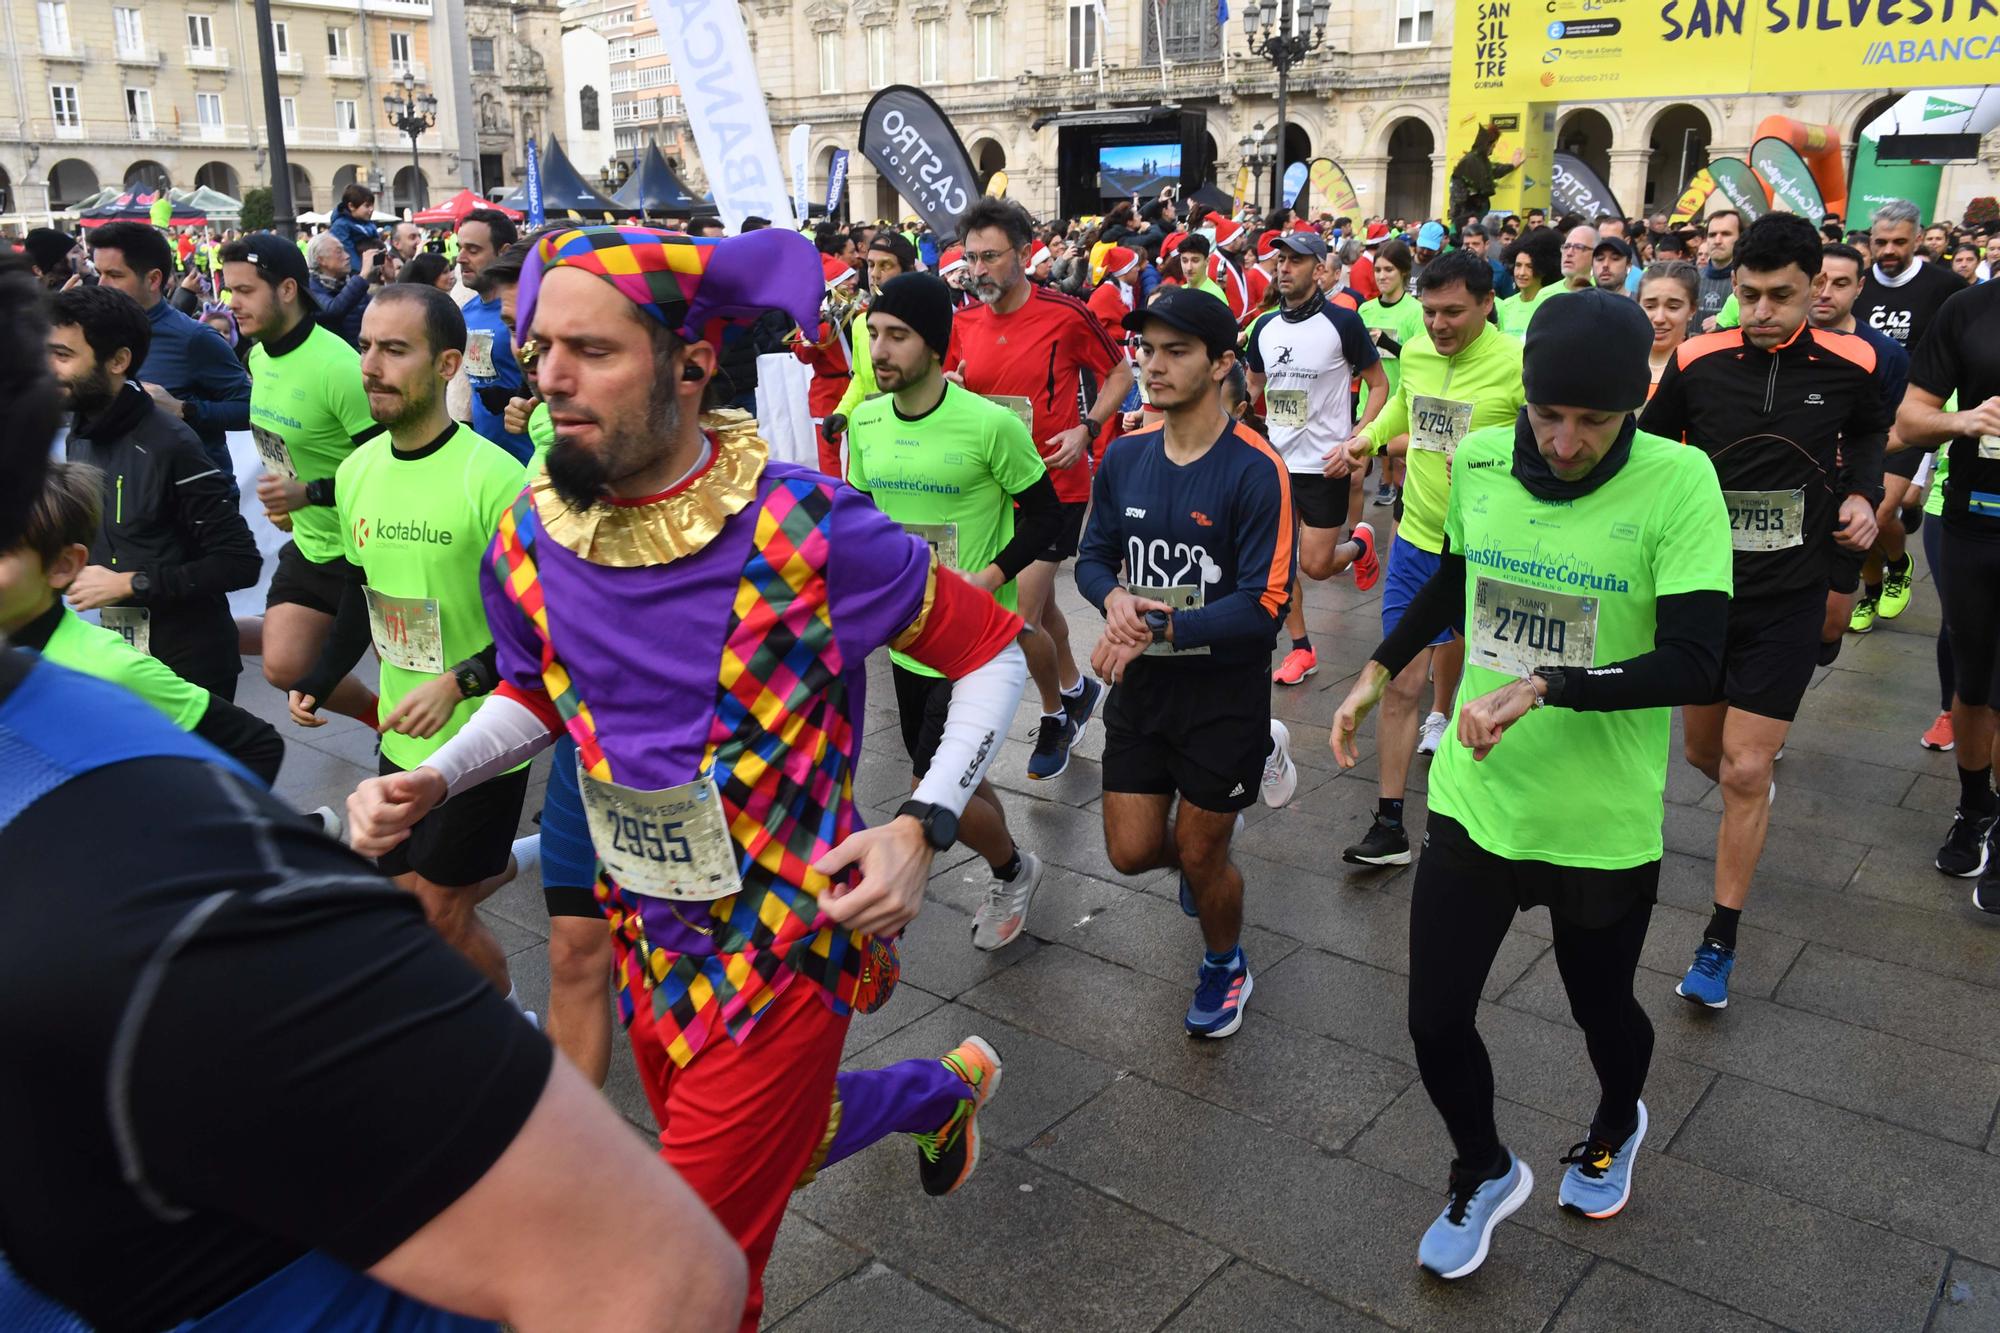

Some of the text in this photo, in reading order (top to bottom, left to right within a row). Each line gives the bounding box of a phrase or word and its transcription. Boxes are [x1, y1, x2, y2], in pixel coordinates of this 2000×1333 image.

[1478, 2, 1511, 20] SAN
[1662, 0, 1745, 41] SAN
[1477, 20, 1508, 41] SIL
[1476, 41, 1507, 60] VES
[1475, 60, 1506, 79] TRE
[1559, 74, 1597, 82] Xacobeo
[1474, 80, 1504, 89] CORUÑA
[1274, 400, 1298, 415] 2743
[1418, 411, 1454, 437] 2794
[1730, 508, 1784, 531] 2793
[376, 518, 453, 546] kotablue
[1465, 543, 1629, 593] SanSilvestreCoruña
[1494, 606, 1566, 654] 2700
[607, 809, 693, 863] 2955
